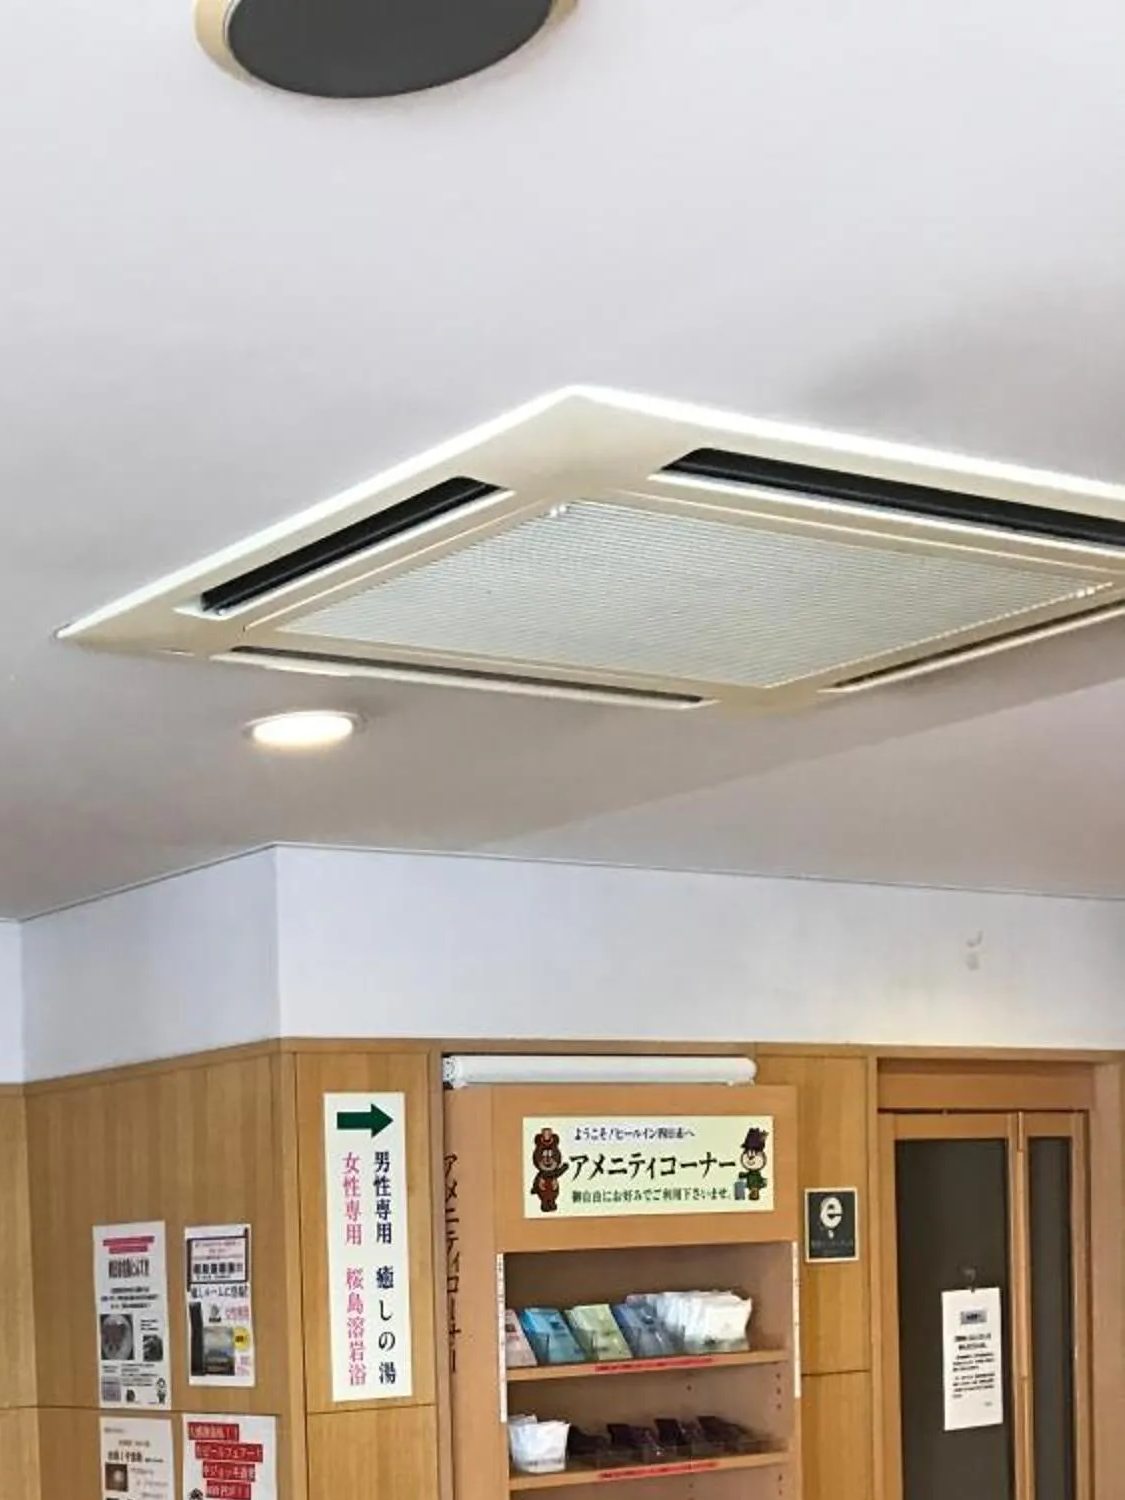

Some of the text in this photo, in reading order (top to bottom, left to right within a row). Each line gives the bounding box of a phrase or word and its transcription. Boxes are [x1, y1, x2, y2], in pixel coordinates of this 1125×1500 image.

[342, 1152, 366, 1386] 女性専用 桜島溶岩浴
[373, 1151, 396, 1385] 男性専用 癒しの湯
[568, 1151, 736, 1181] アメニティコーナー
